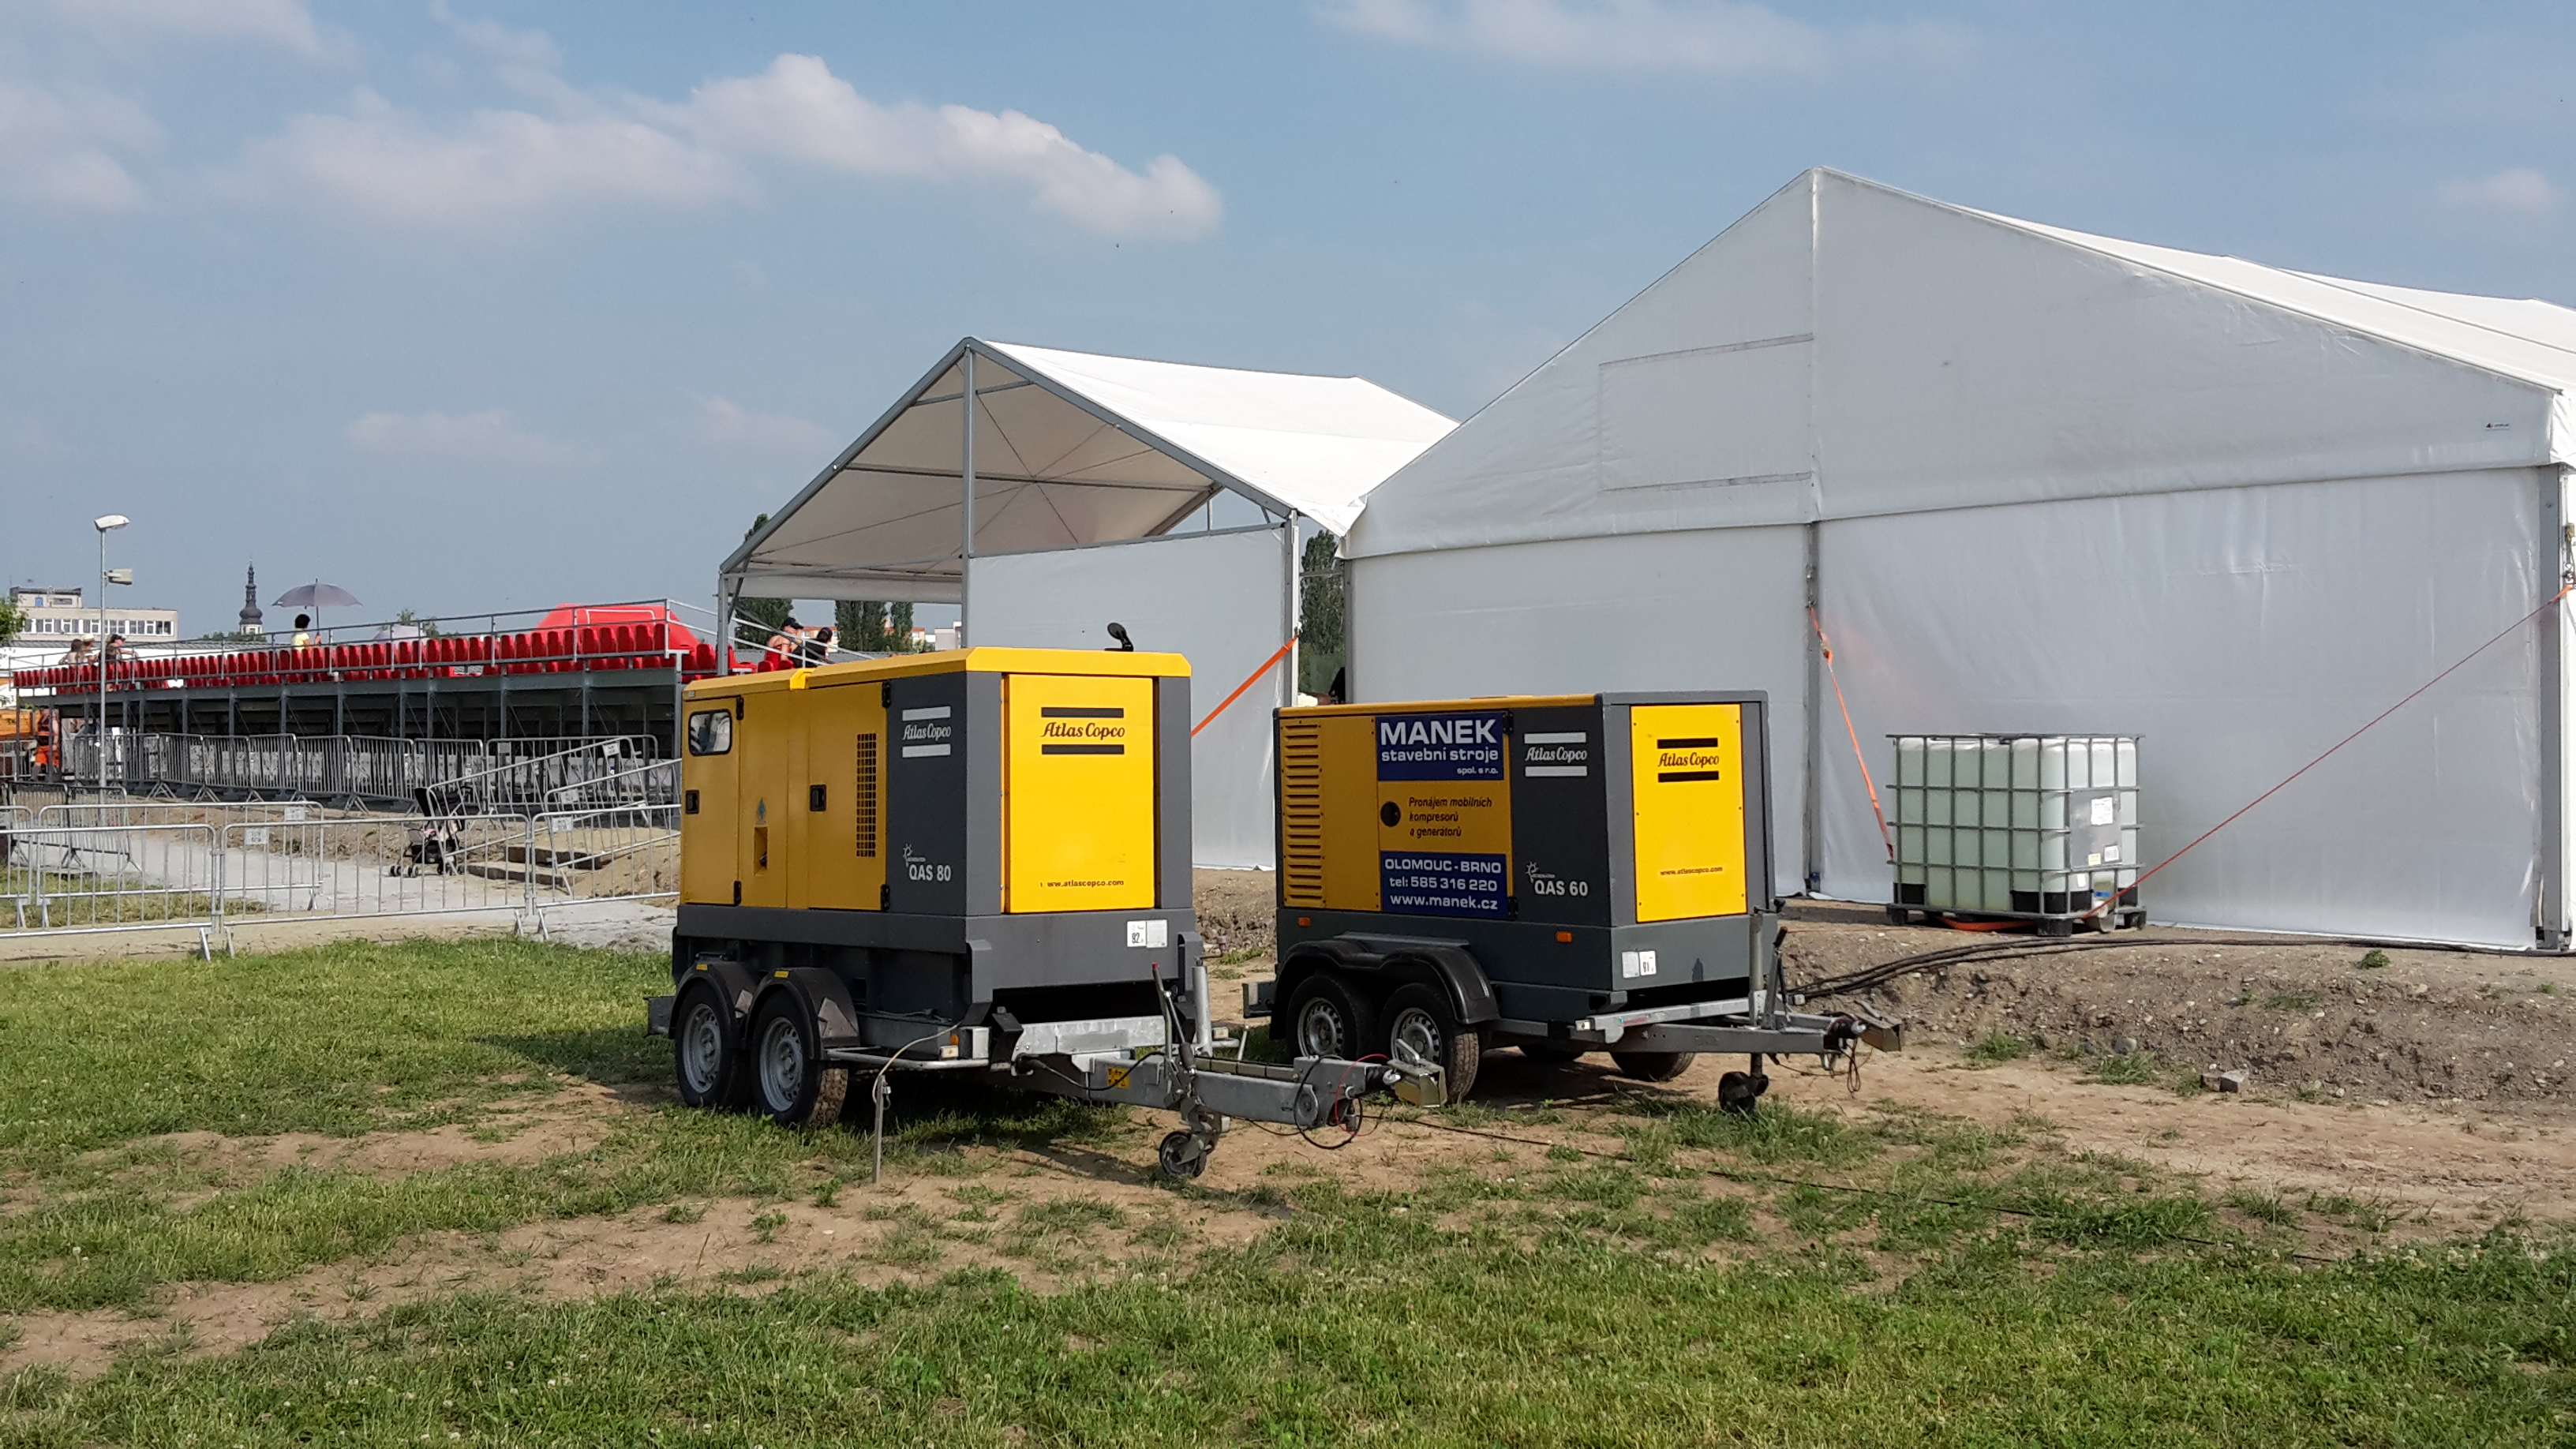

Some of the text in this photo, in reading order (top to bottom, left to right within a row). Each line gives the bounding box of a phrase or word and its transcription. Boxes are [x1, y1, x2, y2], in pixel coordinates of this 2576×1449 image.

[902, 723, 952, 741] Atlas Copco
[1040, 722, 1125, 740] Atlas Copco
[1381, 719, 1497, 746] MANEK
[1382, 747, 1499, 763] stavební stroje
[1525, 747, 1587, 763] Atlas Copco
[1658, 752, 1720, 768] Atlas Copco
[1457, 766, 1477, 776] spol.
[1409, 796, 1492, 809] Pronájem mobilních
[1409, 811, 1458, 823] kompresorů
[1417, 826, 1462, 838] generátorů
[909, 864, 951, 882] QAS 80
[1389, 876, 1497, 892] tel: 585 316 220
[1534, 880, 1588, 897] QAS 60
[1390, 895, 1498, 910] www.manek.cz
